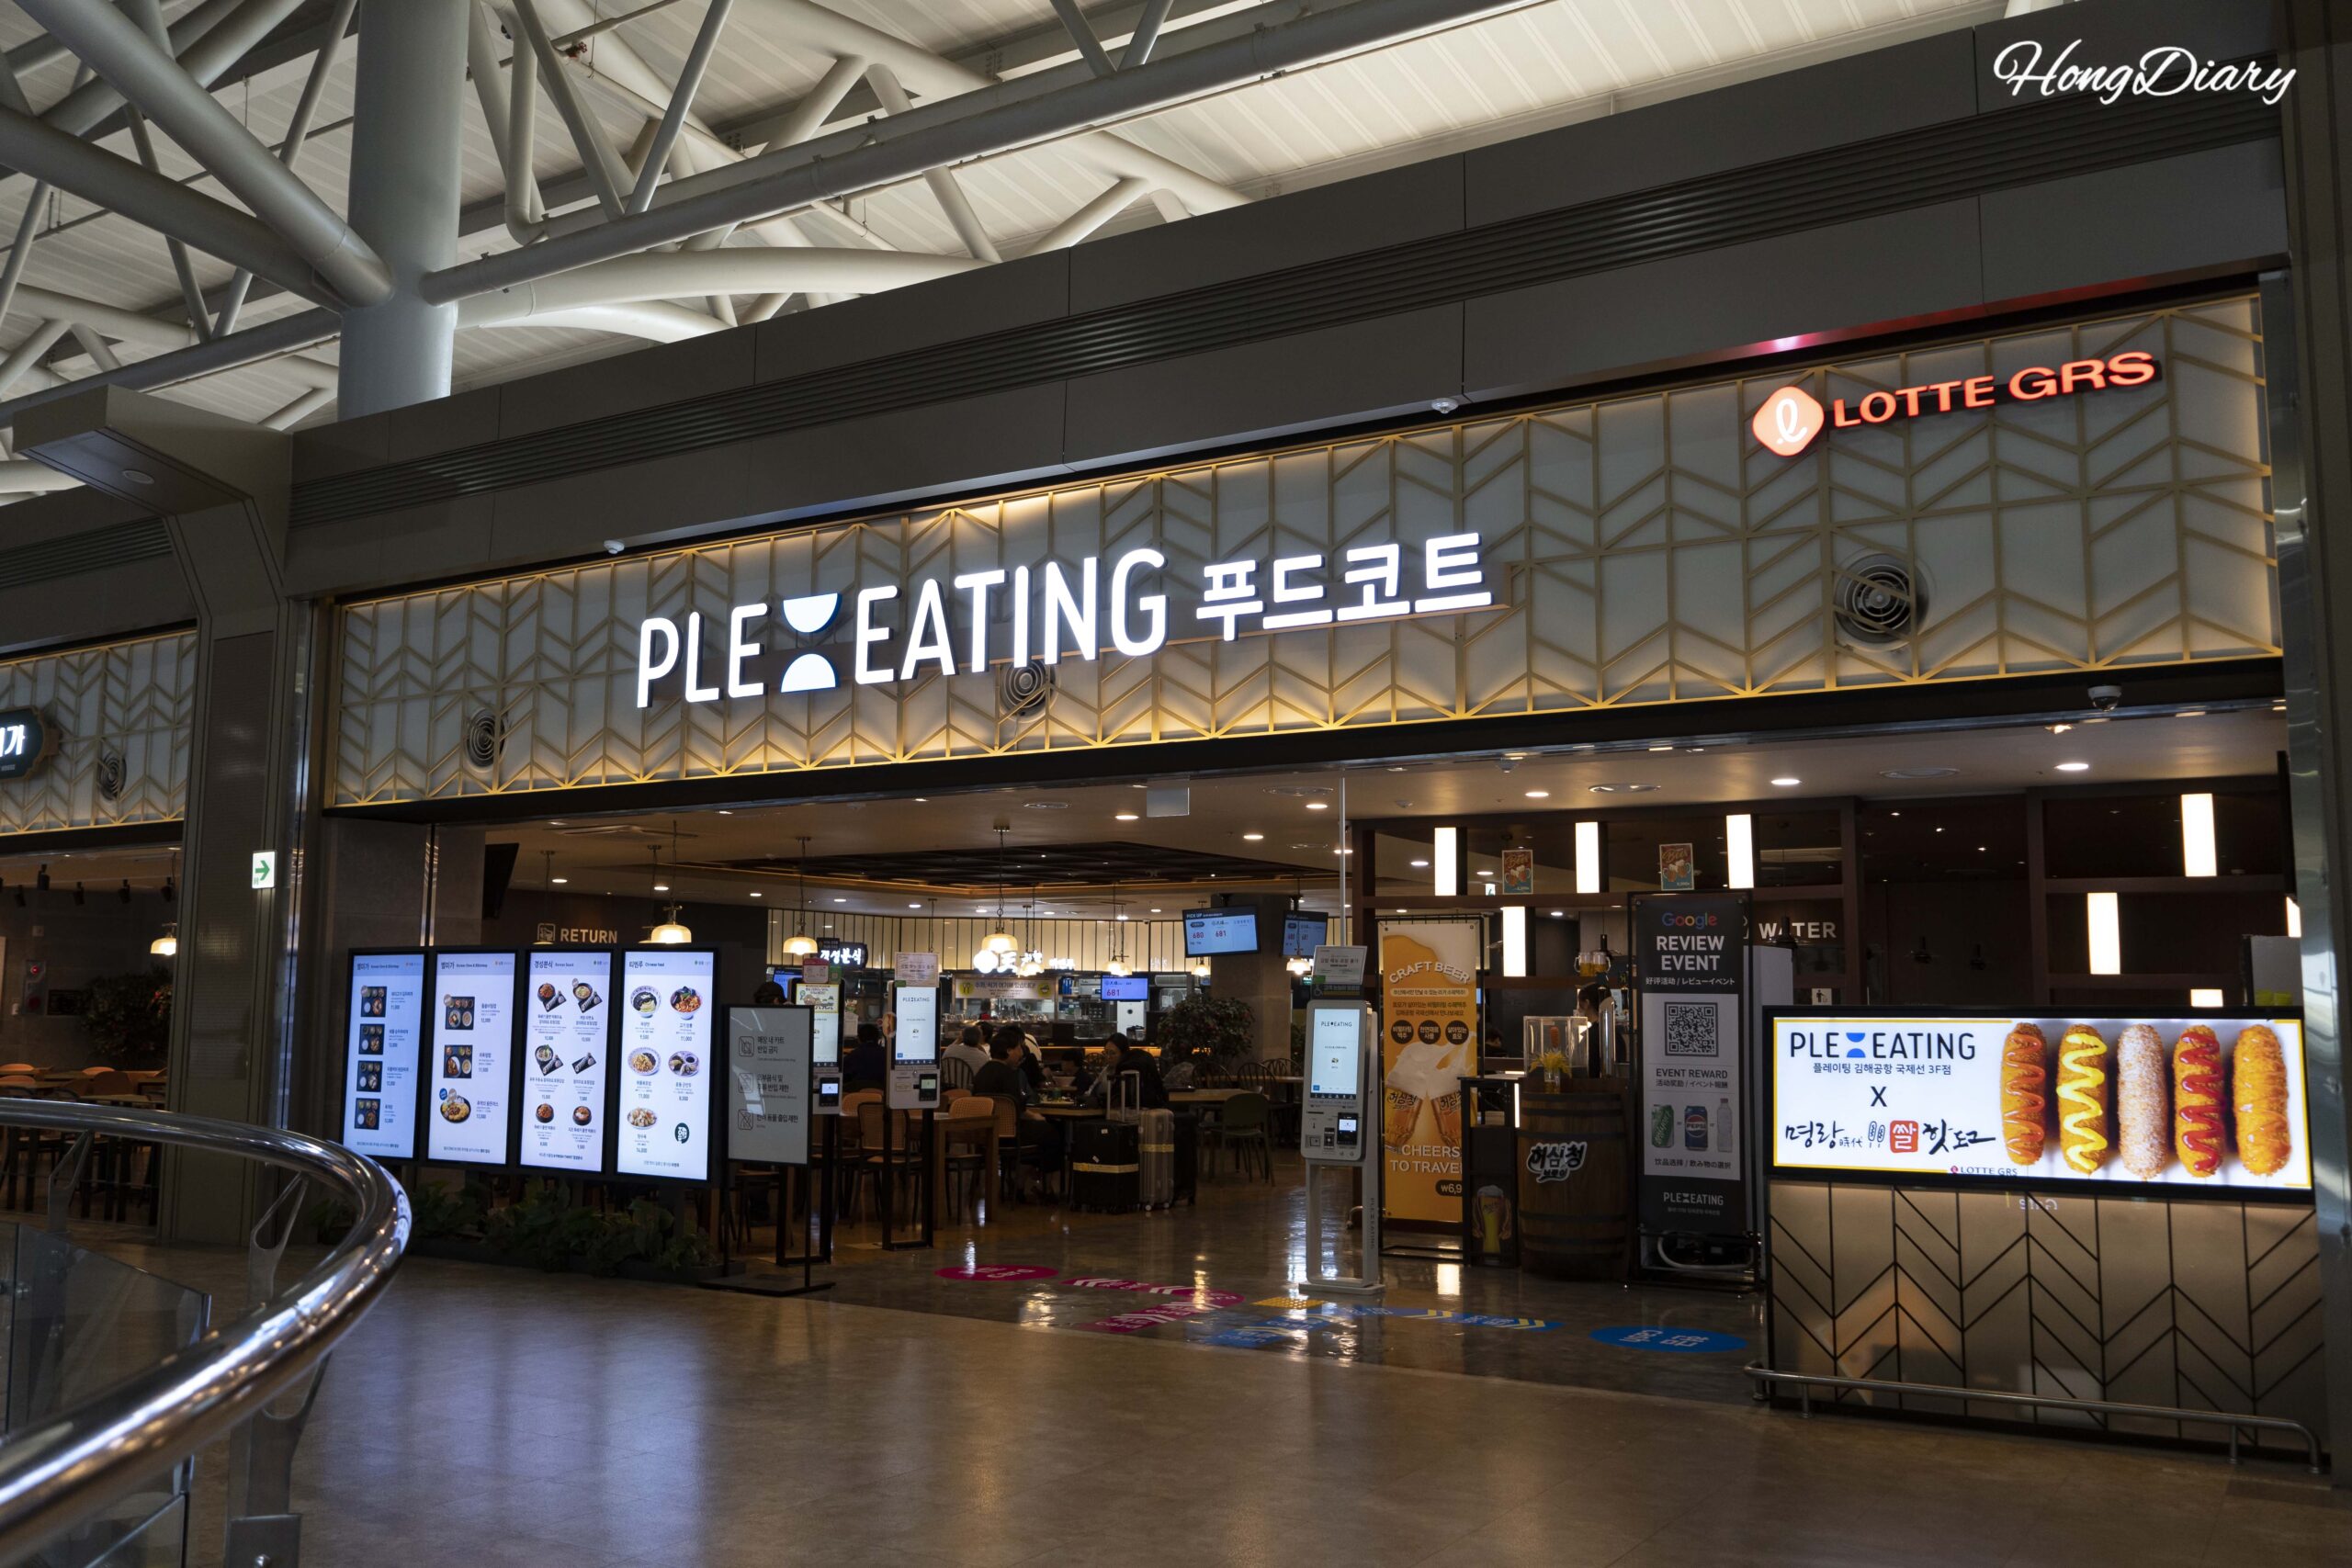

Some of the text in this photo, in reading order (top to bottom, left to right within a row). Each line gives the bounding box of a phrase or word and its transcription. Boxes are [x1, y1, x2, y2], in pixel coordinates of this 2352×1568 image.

[1834, 351, 2157, 429] LOTTE GRS
[638, 532, 1494, 709] PLE EATING 푸드코트
[1662, 912, 1717, 930] Google
[560, 928, 618, 943] RETURN
[1657, 935, 1724, 951] REVIEW
[535, 961, 553, 969] 경성분식
[1661, 954, 1720, 971] EVENT
[1389, 961, 1470, 985] CRAFT BEER
[1682, 977, 1735, 986] レビューイベント
[1106, 988, 1120, 997] 681
[757, 1036, 768, 1044] 매장
[769, 1036, 774, 1044] 내
[1790, 1032, 1976, 1061] PLE EATING
[1657, 1068, 1728, 1079] EVENT REWARD
[1813, 1063, 1952, 1077] 플레이팅 김해공항 국제선 3F점
[767, 1084, 779, 1092] 반입
[779, 1084, 789, 1093] 제한
[1440, 1090, 1462, 1111] 허심
[1871, 1086, 1888, 1108] X
[788, 1115, 798, 1123] 제한
[1785, 1119, 1996, 1156] 명랑 時代 쌀 핫도그
[1401, 1145, 1461, 1158] CHEERS
[1528, 1145, 1585, 1172] 허심청
[1390, 1159, 1462, 1174] TO TRAVE
[1960, 1167, 2018, 1177] LOTTE GRS
[1441, 1183, 1462, 1195] ₩6,9
[1663, 1192, 1724, 1206] PLE EATING
